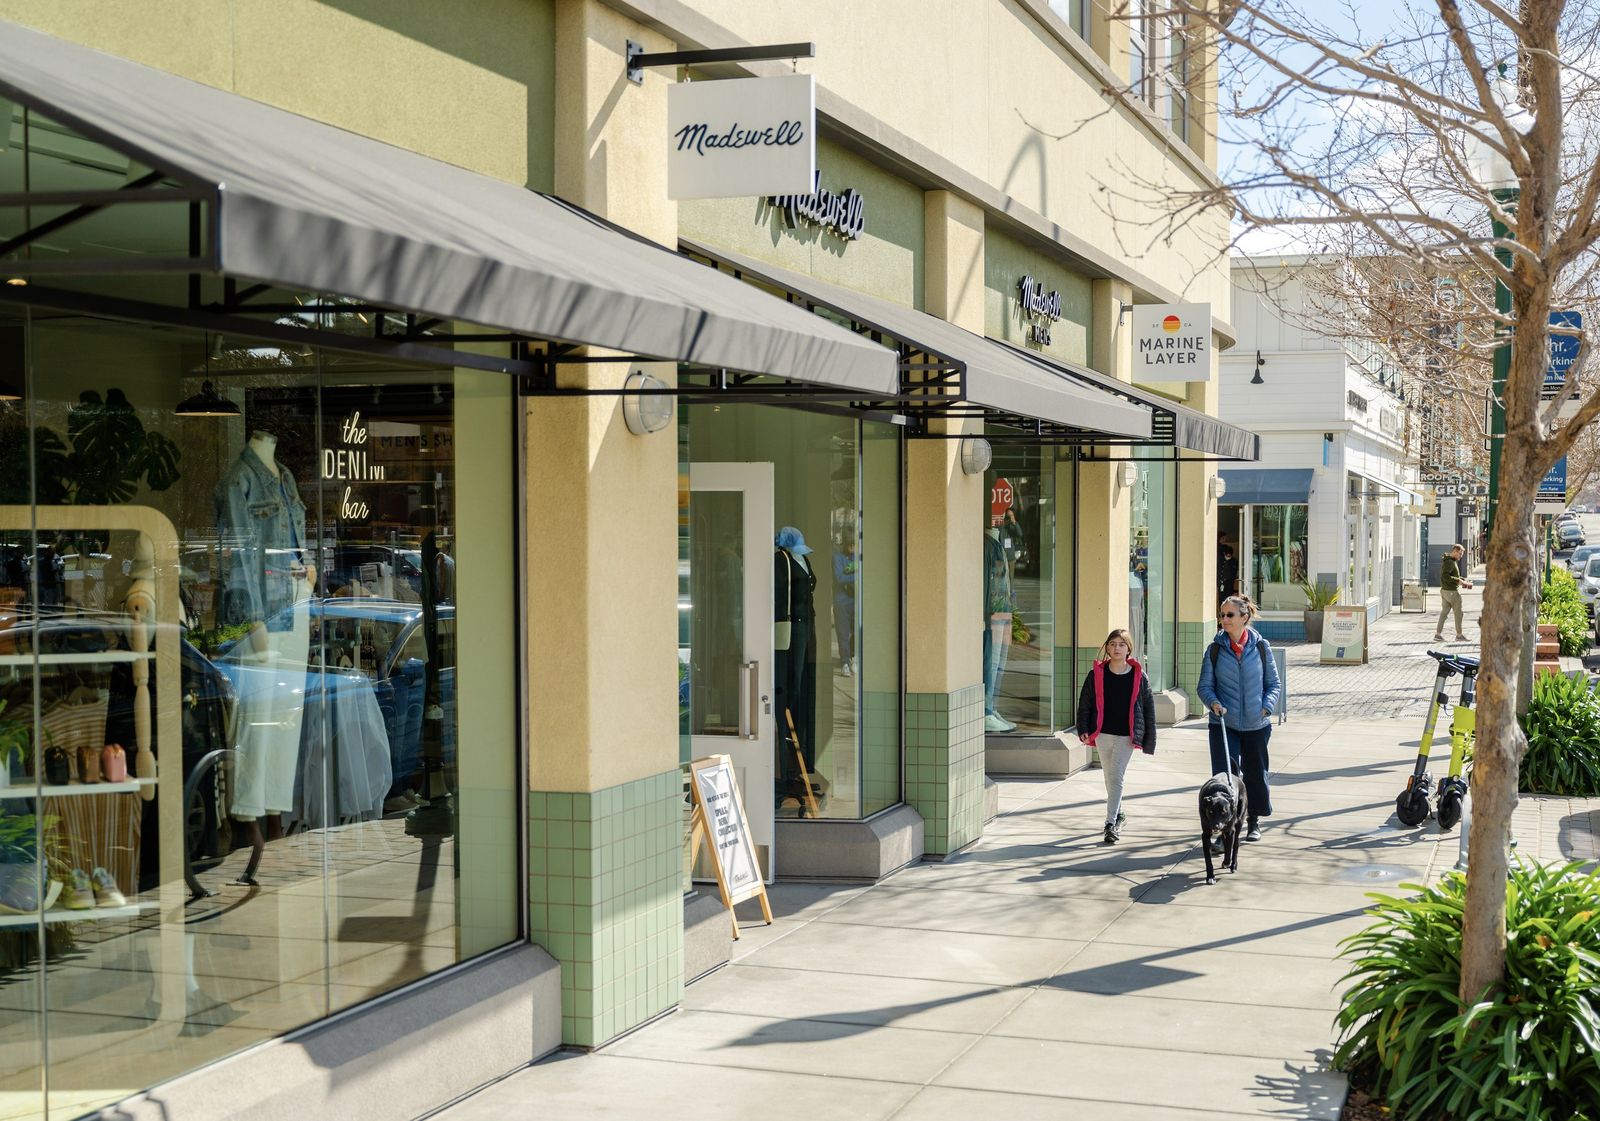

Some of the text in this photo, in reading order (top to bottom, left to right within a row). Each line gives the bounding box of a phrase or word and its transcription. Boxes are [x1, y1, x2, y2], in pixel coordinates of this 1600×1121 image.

[674, 120, 803, 157] Madewell
[1017, 275, 1061, 321] Madewell
[1140, 336, 1204, 352] MARINE
[1145, 352, 1197, 365] LAYER
[1552, 357, 1576, 366] rkin
[343, 411, 367, 444] the
[1543, 475, 1564, 484] arking
[341, 486, 370, 519] bar
